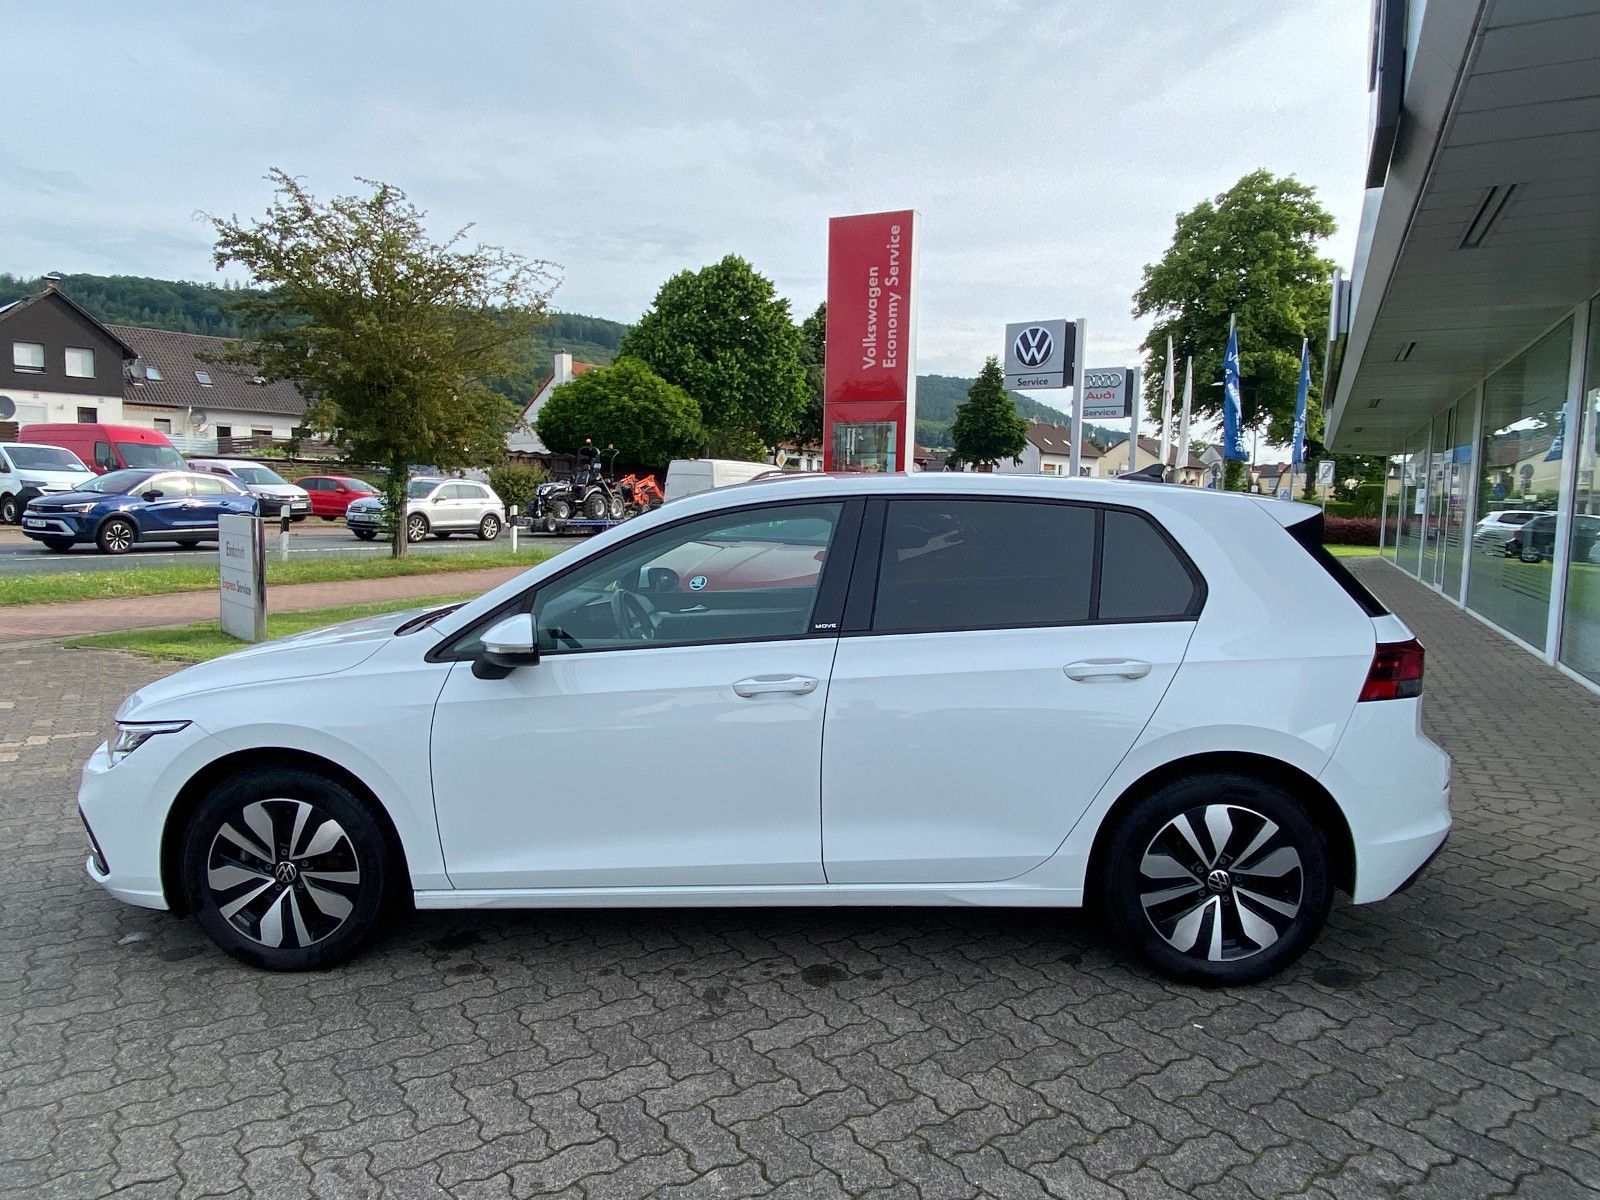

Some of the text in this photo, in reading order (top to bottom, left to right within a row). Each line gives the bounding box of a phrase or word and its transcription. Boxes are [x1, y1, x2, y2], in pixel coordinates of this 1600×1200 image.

[882, 224, 902, 368] Economy Service
[862, 266, 881, 369] Volkswagen
[1017, 377, 1049, 387] Service
[1085, 391, 1116, 401] Audi
[1083, 408, 1117, 417] Service
